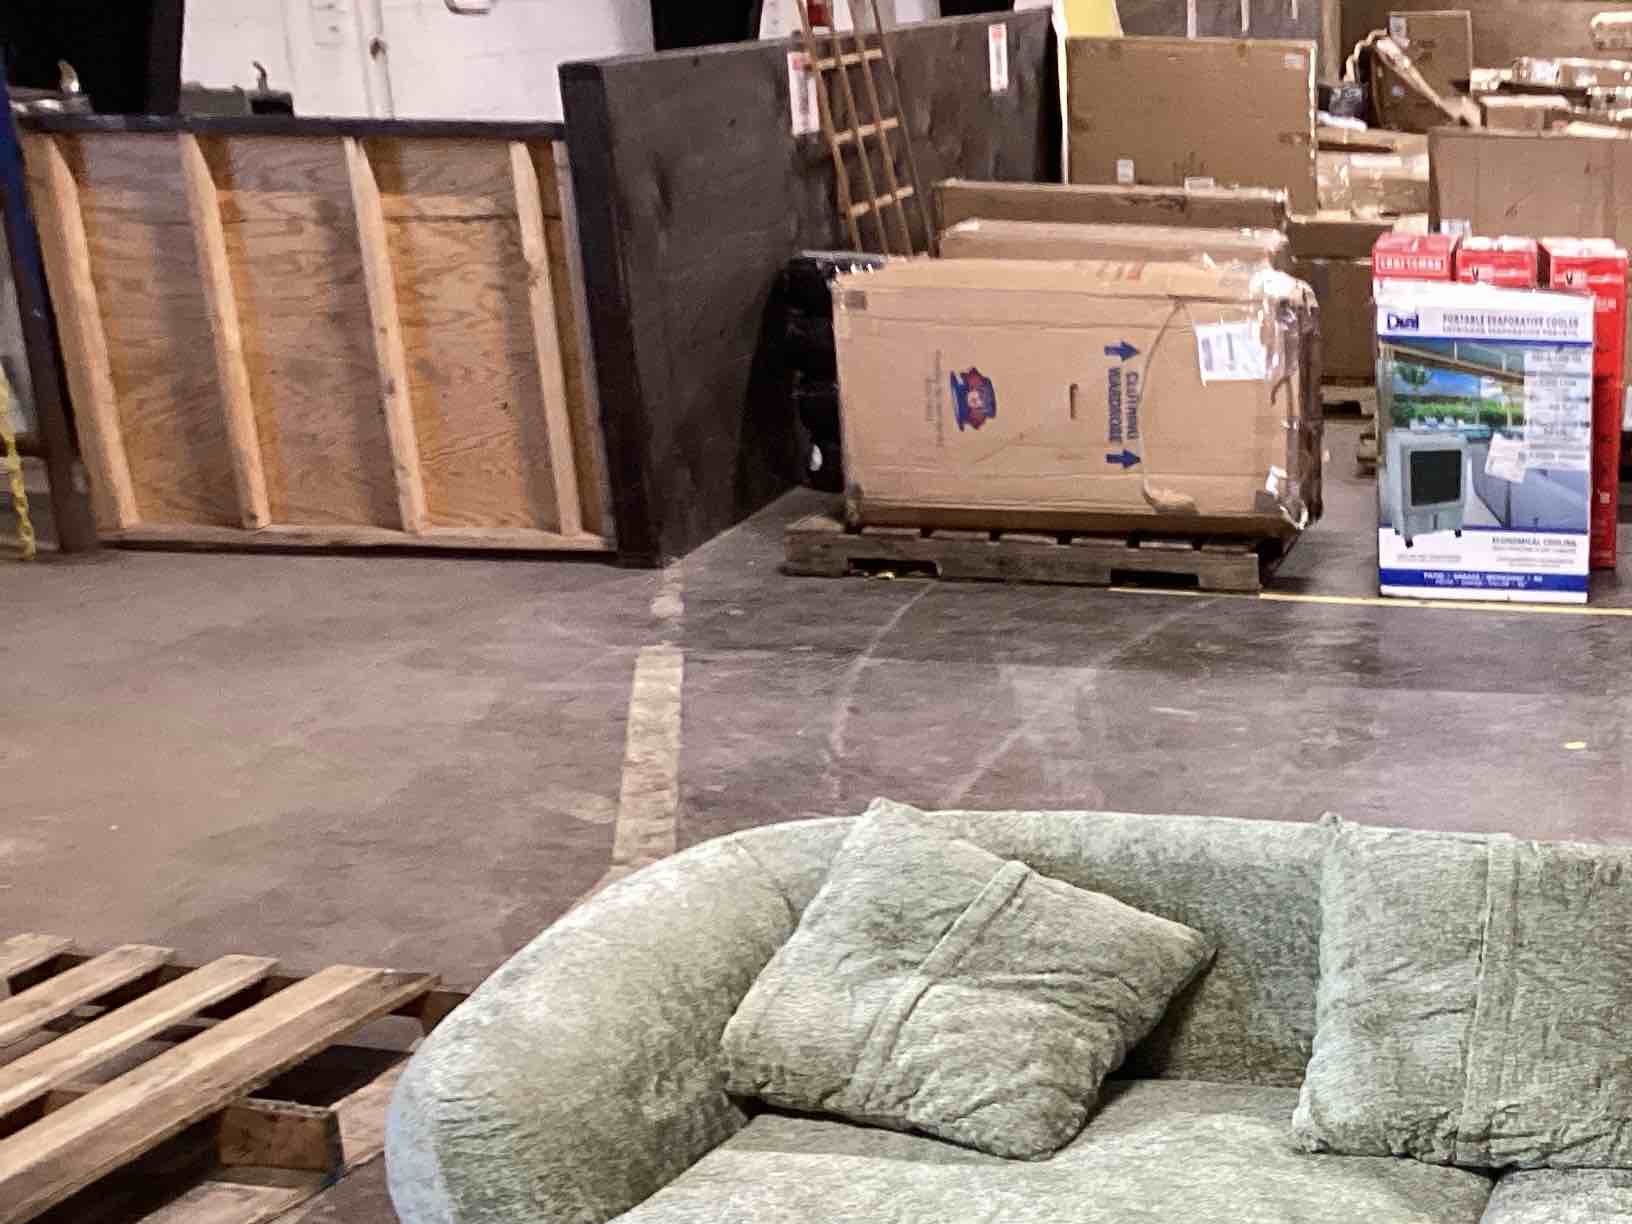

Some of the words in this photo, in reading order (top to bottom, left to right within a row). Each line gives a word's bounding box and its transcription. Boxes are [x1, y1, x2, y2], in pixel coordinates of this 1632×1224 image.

[1443, 313, 1484, 325] PORTABLE
[1487, 314, 1543, 327] EVAPORATIVE
[1546, 317, 1579, 329] COOLER
